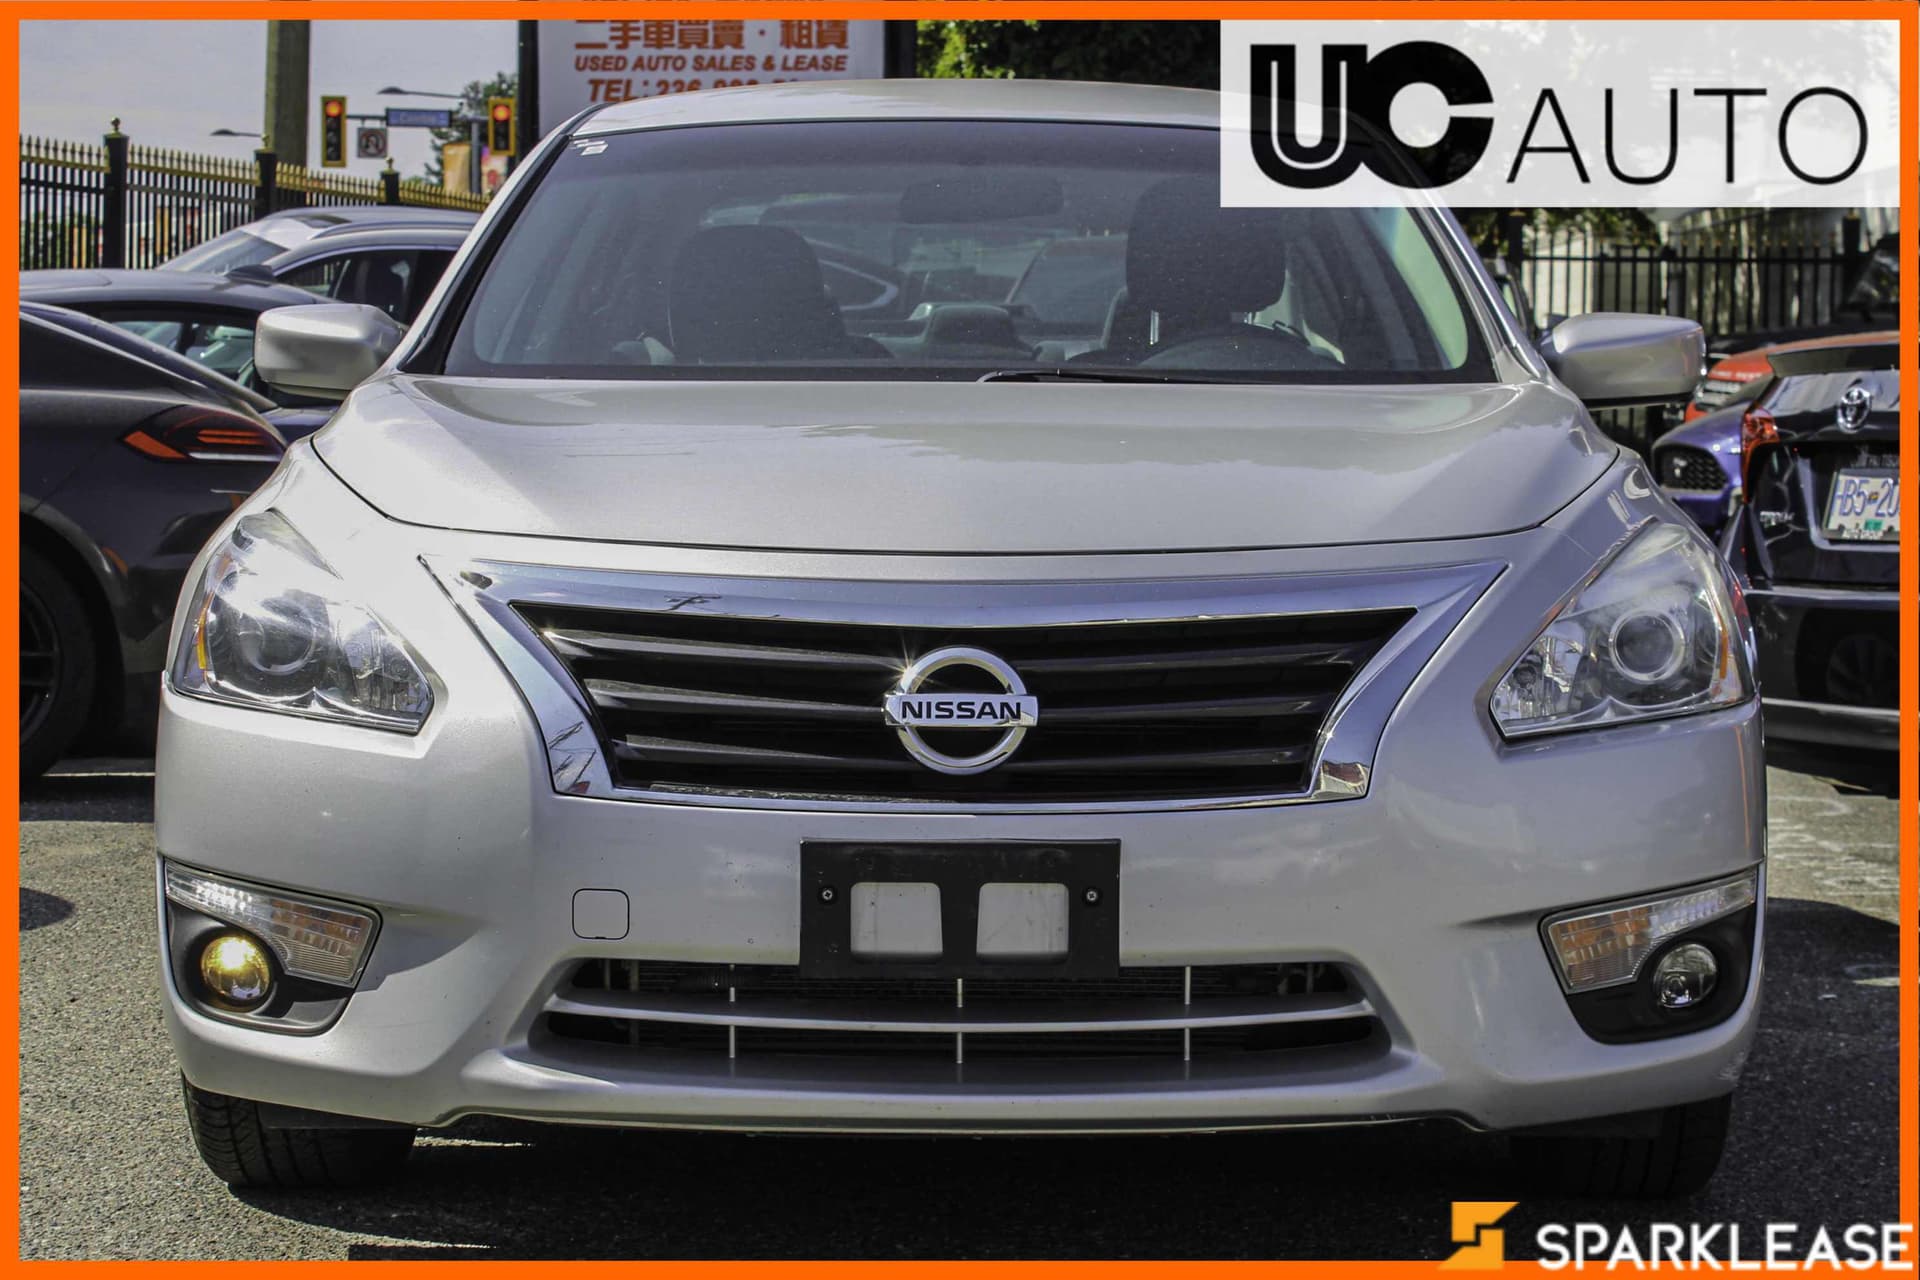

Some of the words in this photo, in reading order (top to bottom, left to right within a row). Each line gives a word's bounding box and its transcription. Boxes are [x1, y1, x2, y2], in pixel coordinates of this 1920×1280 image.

[575, 55, 627, 71] USED
[632, 55, 686, 71] AUTO
[692, 55, 757, 71] SALES
[762, 55, 776, 71] &
[781, 55, 848, 71] LEASE
[902, 701, 1021, 720] NISSAN
